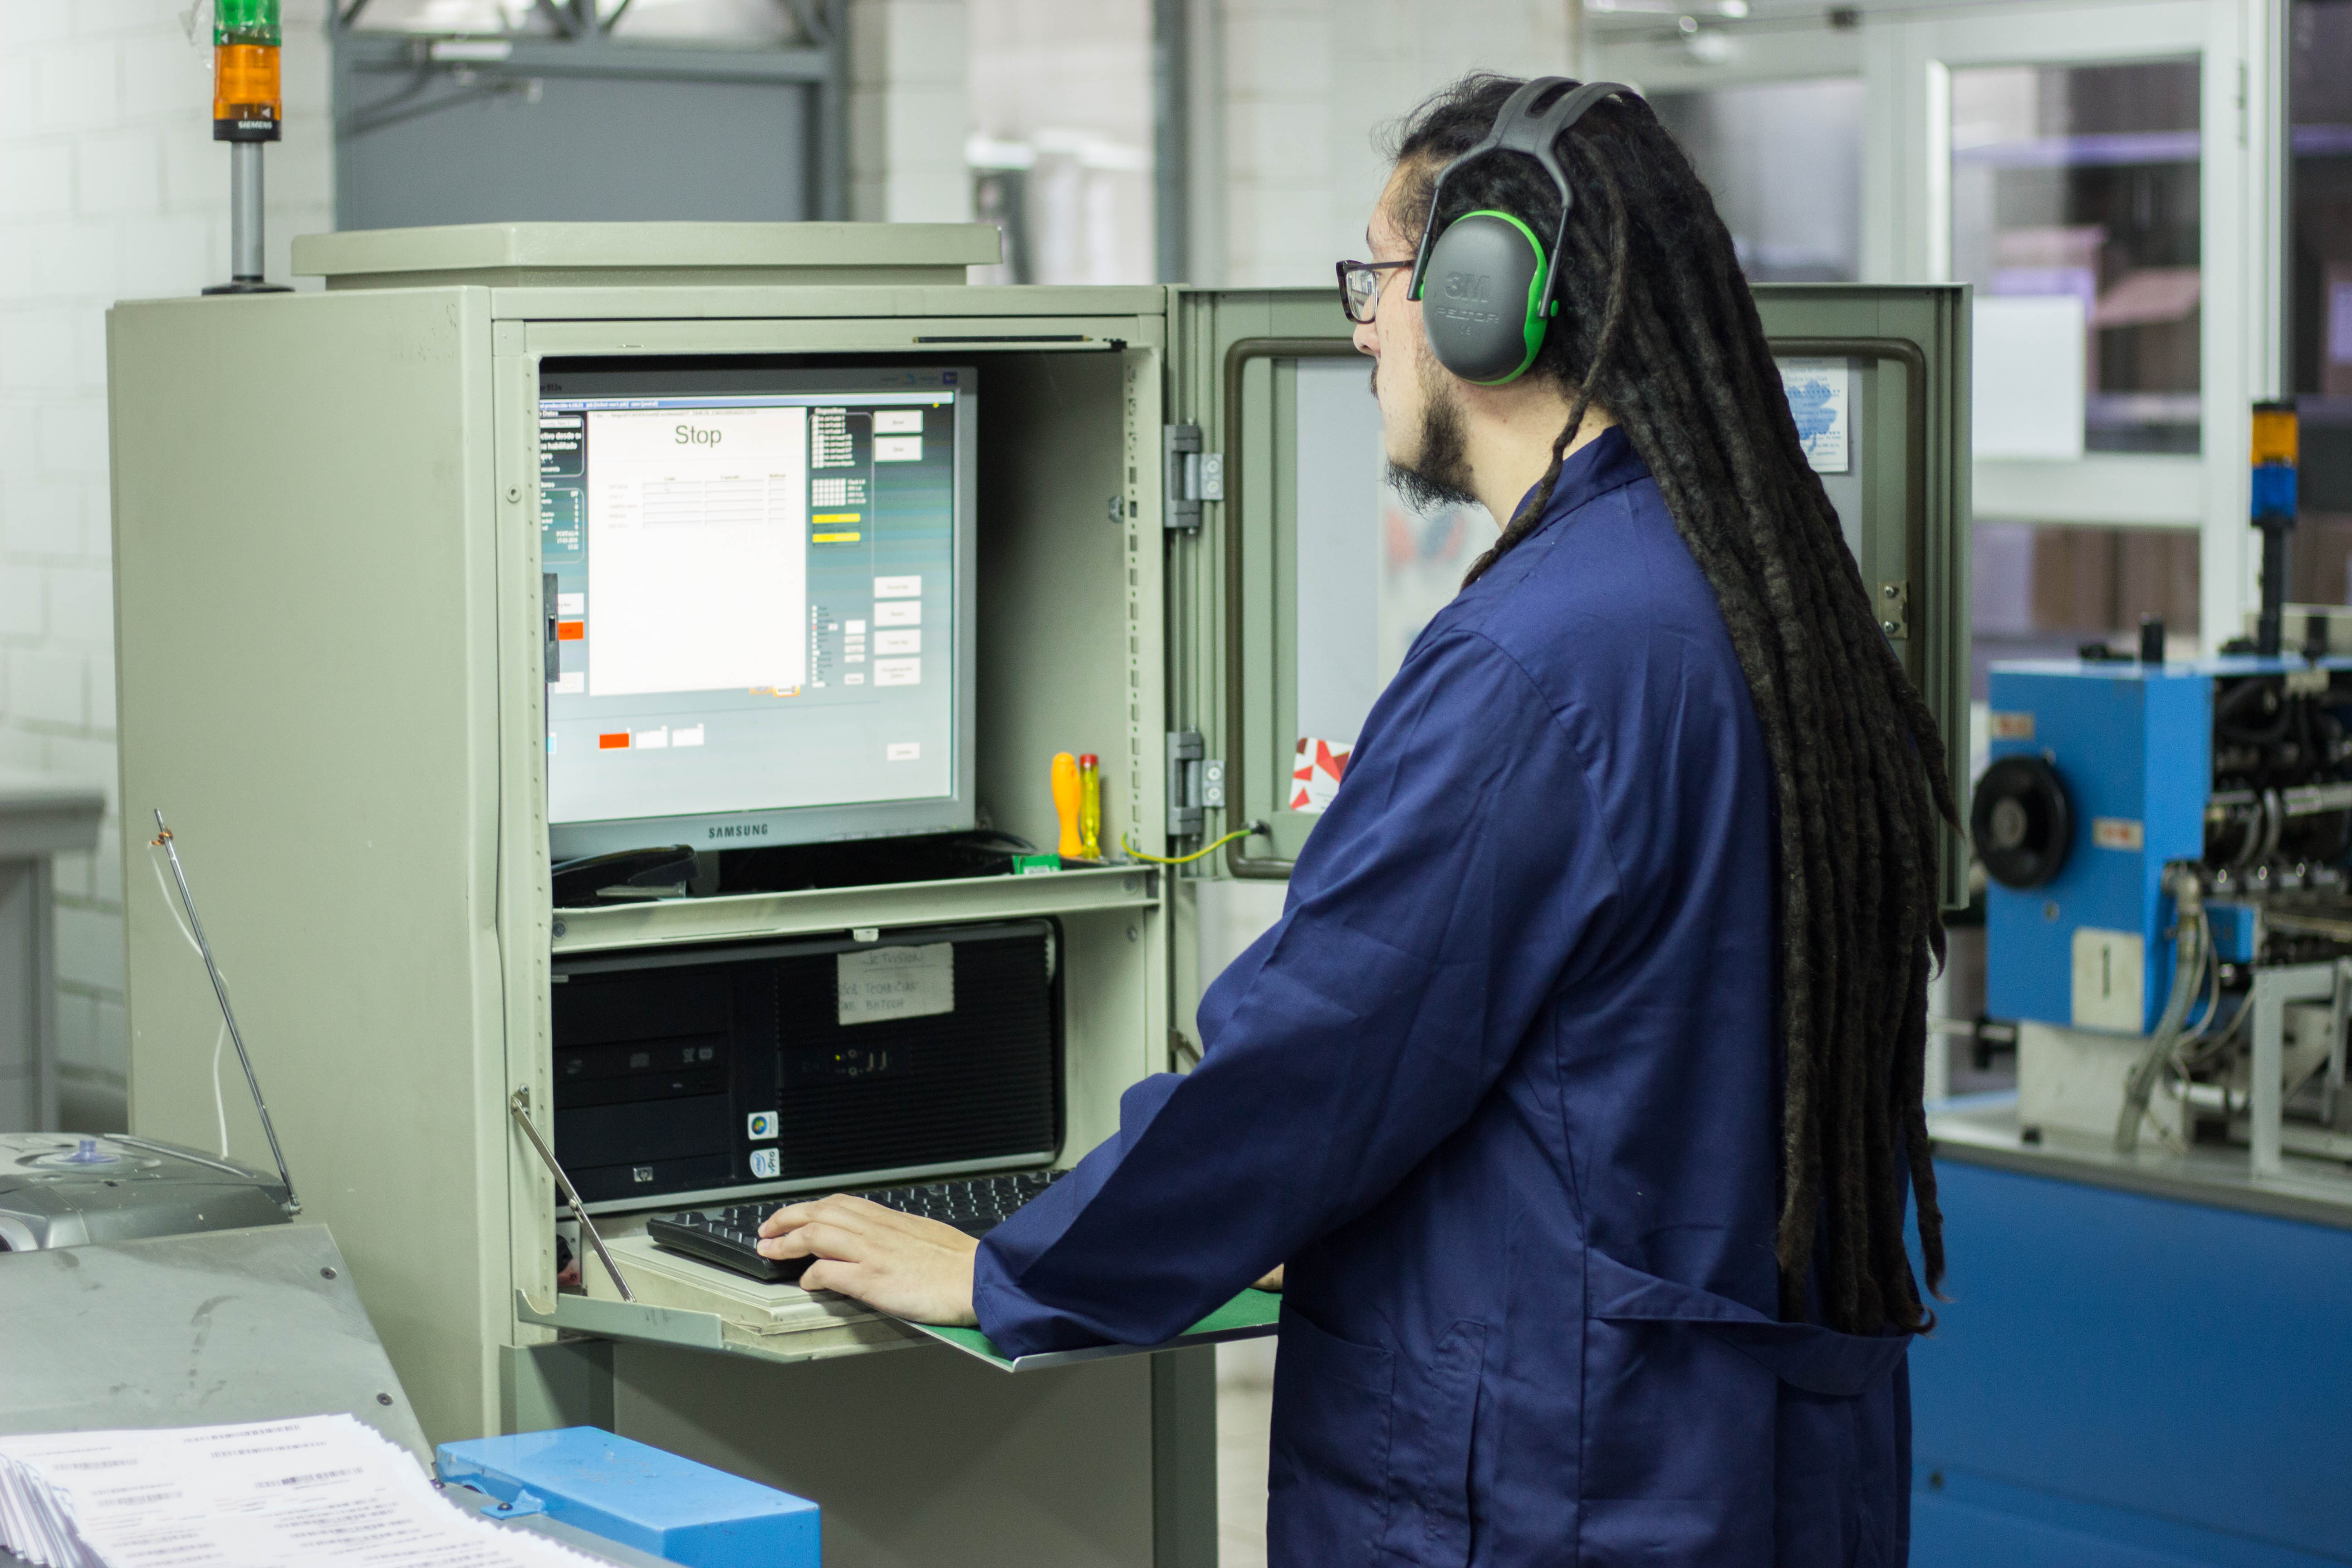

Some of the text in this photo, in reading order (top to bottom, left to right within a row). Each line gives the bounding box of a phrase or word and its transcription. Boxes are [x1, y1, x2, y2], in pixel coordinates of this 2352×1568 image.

[238, 120, 272, 130] SIEMENS
[1444, 272, 1491, 303] 3M
[675, 425, 722, 448] Stop
[709, 823, 768, 839] SAMSUNG
